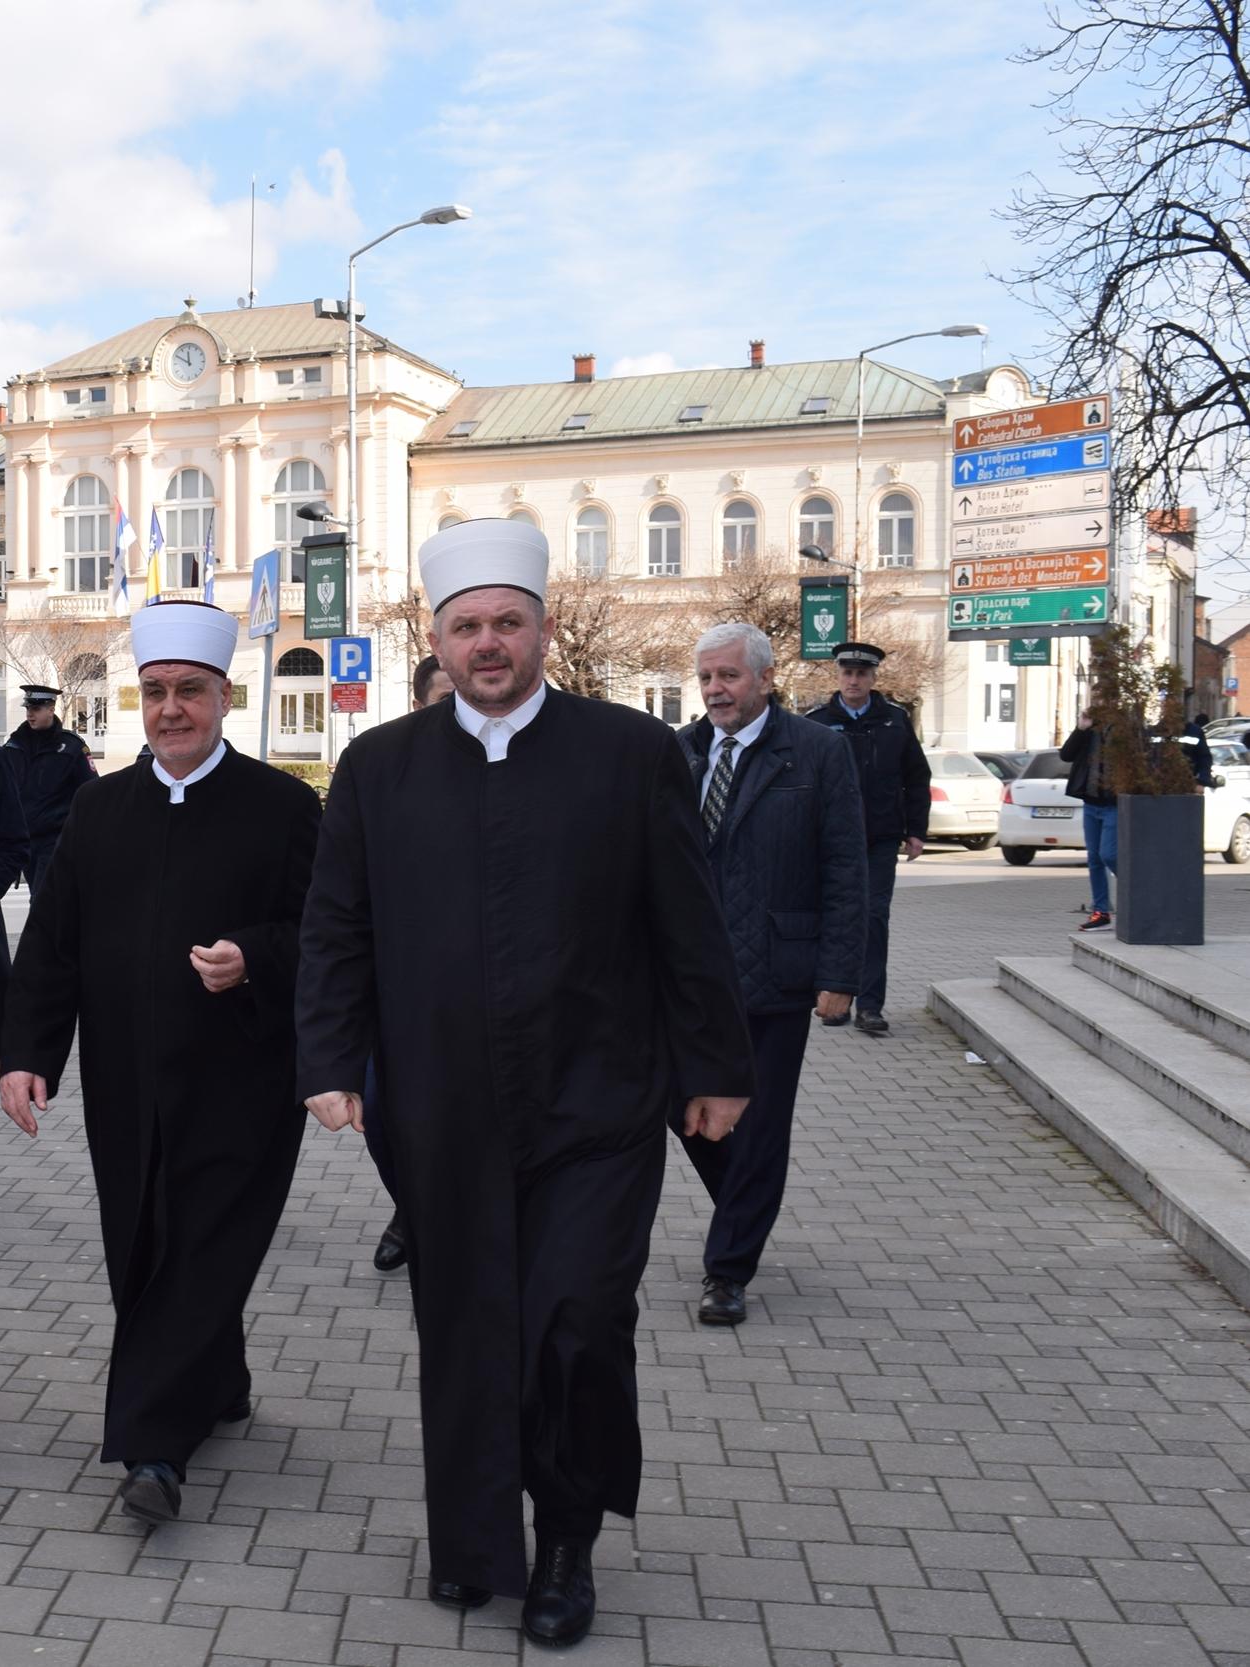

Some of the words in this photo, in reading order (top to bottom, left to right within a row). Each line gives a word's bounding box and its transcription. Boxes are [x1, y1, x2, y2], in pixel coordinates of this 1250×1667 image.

[1013, 413, 1034, 426] Храм
[978, 429, 1014, 444] Cathedral
[1015, 425, 1042, 438] Church
[978, 452, 1020, 468] Аутобуска
[1022, 447, 1057, 459] станица
[977, 468, 994, 480] Bus
[995, 465, 1026, 478] Station
[977, 490, 1000, 501] Хотел
[1004, 488, 1029, 499] Дрина
[977, 504, 999, 516] Drina
[1001, 501, 1023, 512] Hotel
[976, 527, 1000, 537] Хотел
[995, 538, 1018, 549] Hotel
[975, 561, 1012, 575] Манастир
[988, 574, 1016, 587] Vasilije
[1037, 570, 1081, 582] Monastery
[975, 598, 1009, 610] Градски
[1011, 597, 1030, 608] парк
[993, 610, 1012, 621] Park
[340, 643, 362, 676] P
[1228, 679, 1236, 688] P
